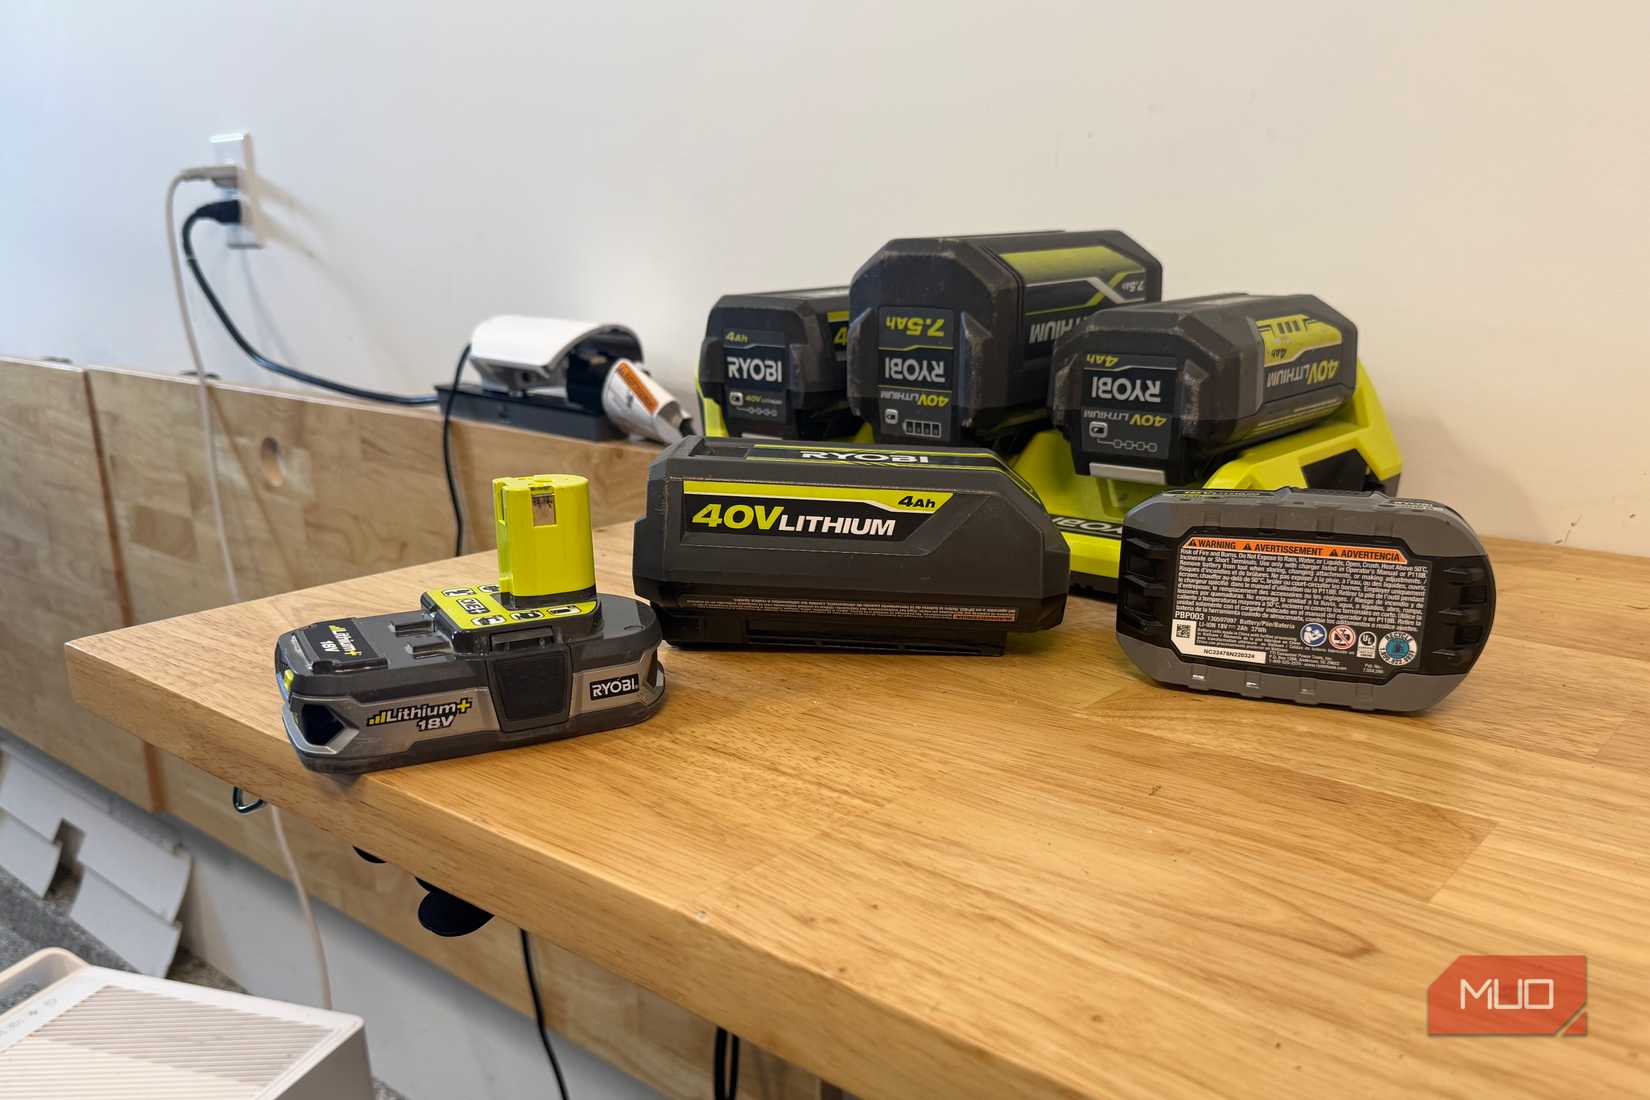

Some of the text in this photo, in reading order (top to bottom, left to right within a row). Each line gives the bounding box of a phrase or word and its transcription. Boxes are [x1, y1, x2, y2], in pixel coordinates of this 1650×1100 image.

[885, 316, 945, 337] 7.5Ah
[725, 331, 749, 343] 4Ah
[726, 356, 783, 383] RYOBI
[884, 357, 946, 383] RYOBI
[1086, 354, 1119, 368] 4Ah
[1091, 376, 1161, 403] RYOBI
[800, 450, 929, 464] RYOBI
[898, 495, 937, 510] 4Ah
[1198, 539, 1401, 563] WARNING AVERTISSEMENT ADVERTENCIA
[1175, 611, 1204, 620] PBP003
[592, 678, 638, 698] RYOBI
[418, 714, 455, 731] 18V
